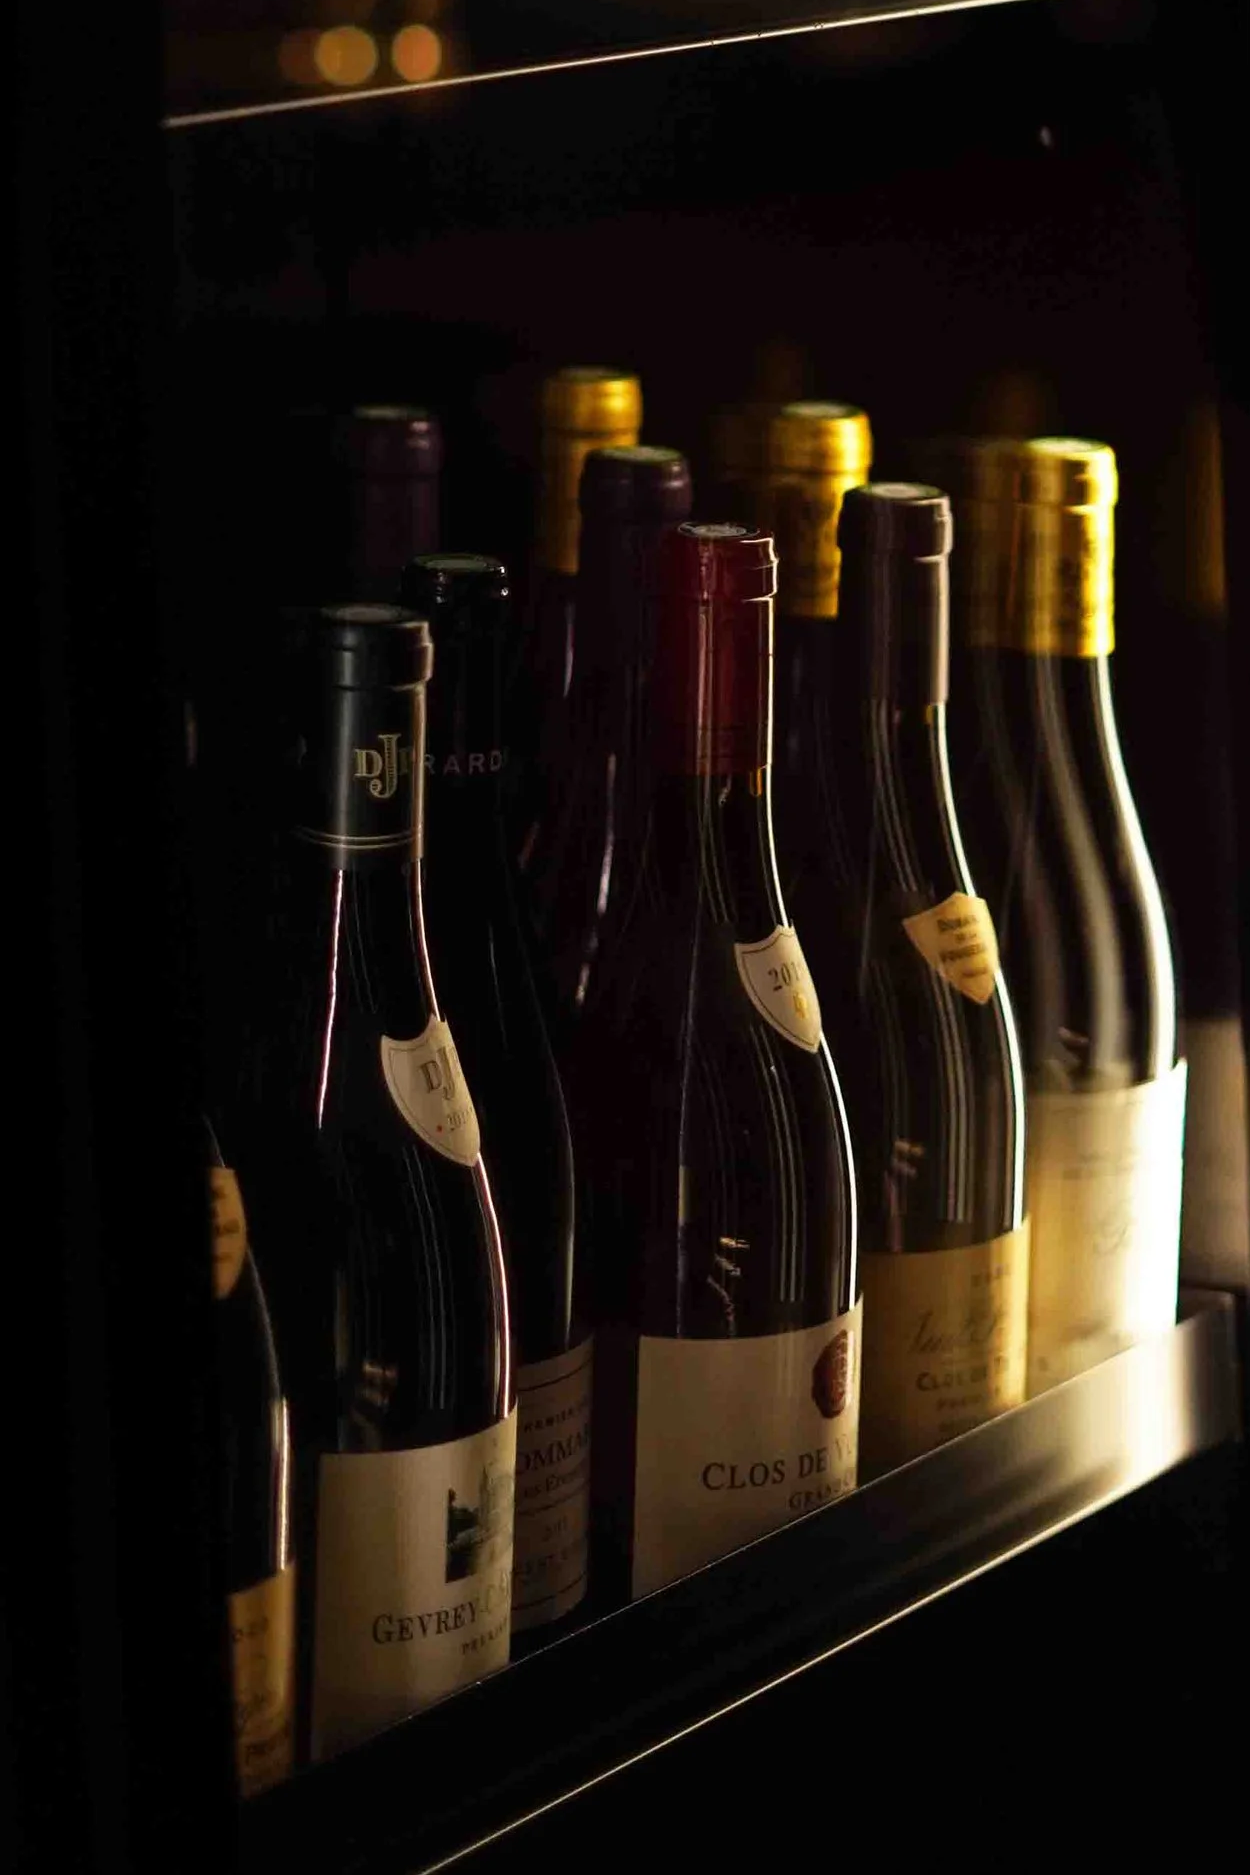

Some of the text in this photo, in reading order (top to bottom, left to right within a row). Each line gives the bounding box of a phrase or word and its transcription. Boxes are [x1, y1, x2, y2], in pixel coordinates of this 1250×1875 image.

[354, 733, 402, 799] DJ
[702, 1460, 786, 1491] CLOS
[798, 1446, 829, 1479] DE
